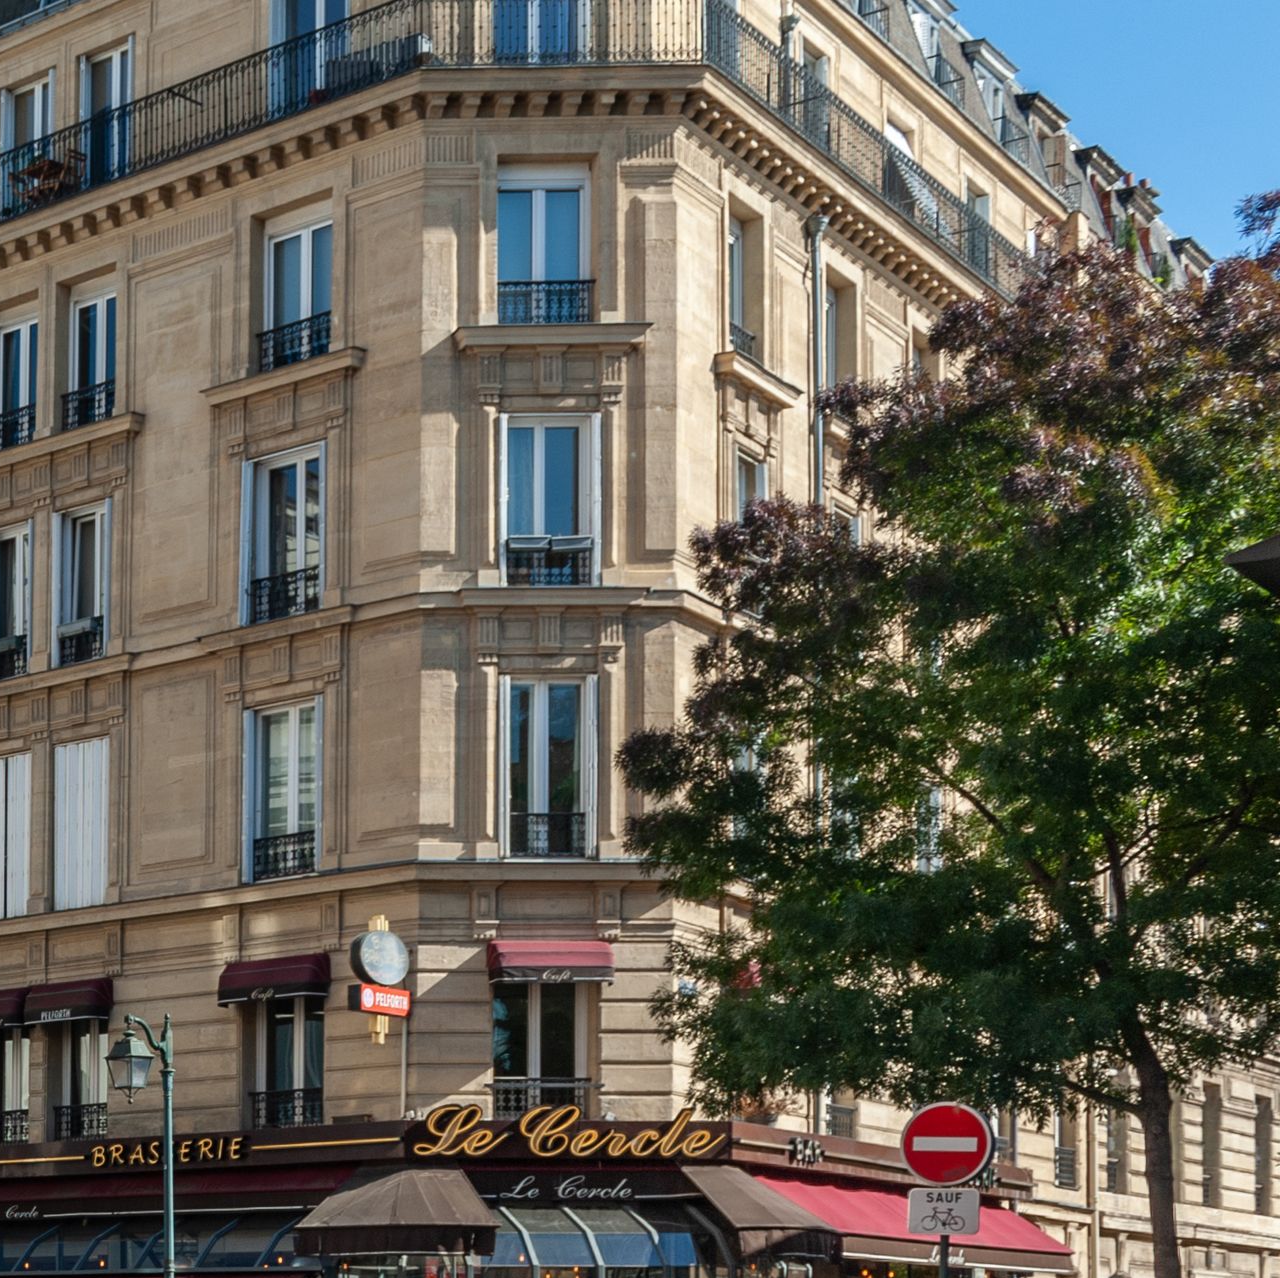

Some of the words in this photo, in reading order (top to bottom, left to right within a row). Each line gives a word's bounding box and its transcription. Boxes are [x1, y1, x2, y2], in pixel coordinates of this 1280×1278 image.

[541, 967, 573, 983] Café
[250, 987, 275, 1001] Café
[374, 991, 409, 1011] PELFORTH
[413, 1103, 514, 1157] Le
[519, 1103, 728, 1158] Cercle
[91, 1137, 244, 1168] BRASERIE
[498, 1174, 540, 1200] Le
[553, 1174, 633, 1200] Cercle
[925, 1191, 963, 1204] SAUF
[5, 1204, 40, 1220] Cercle
